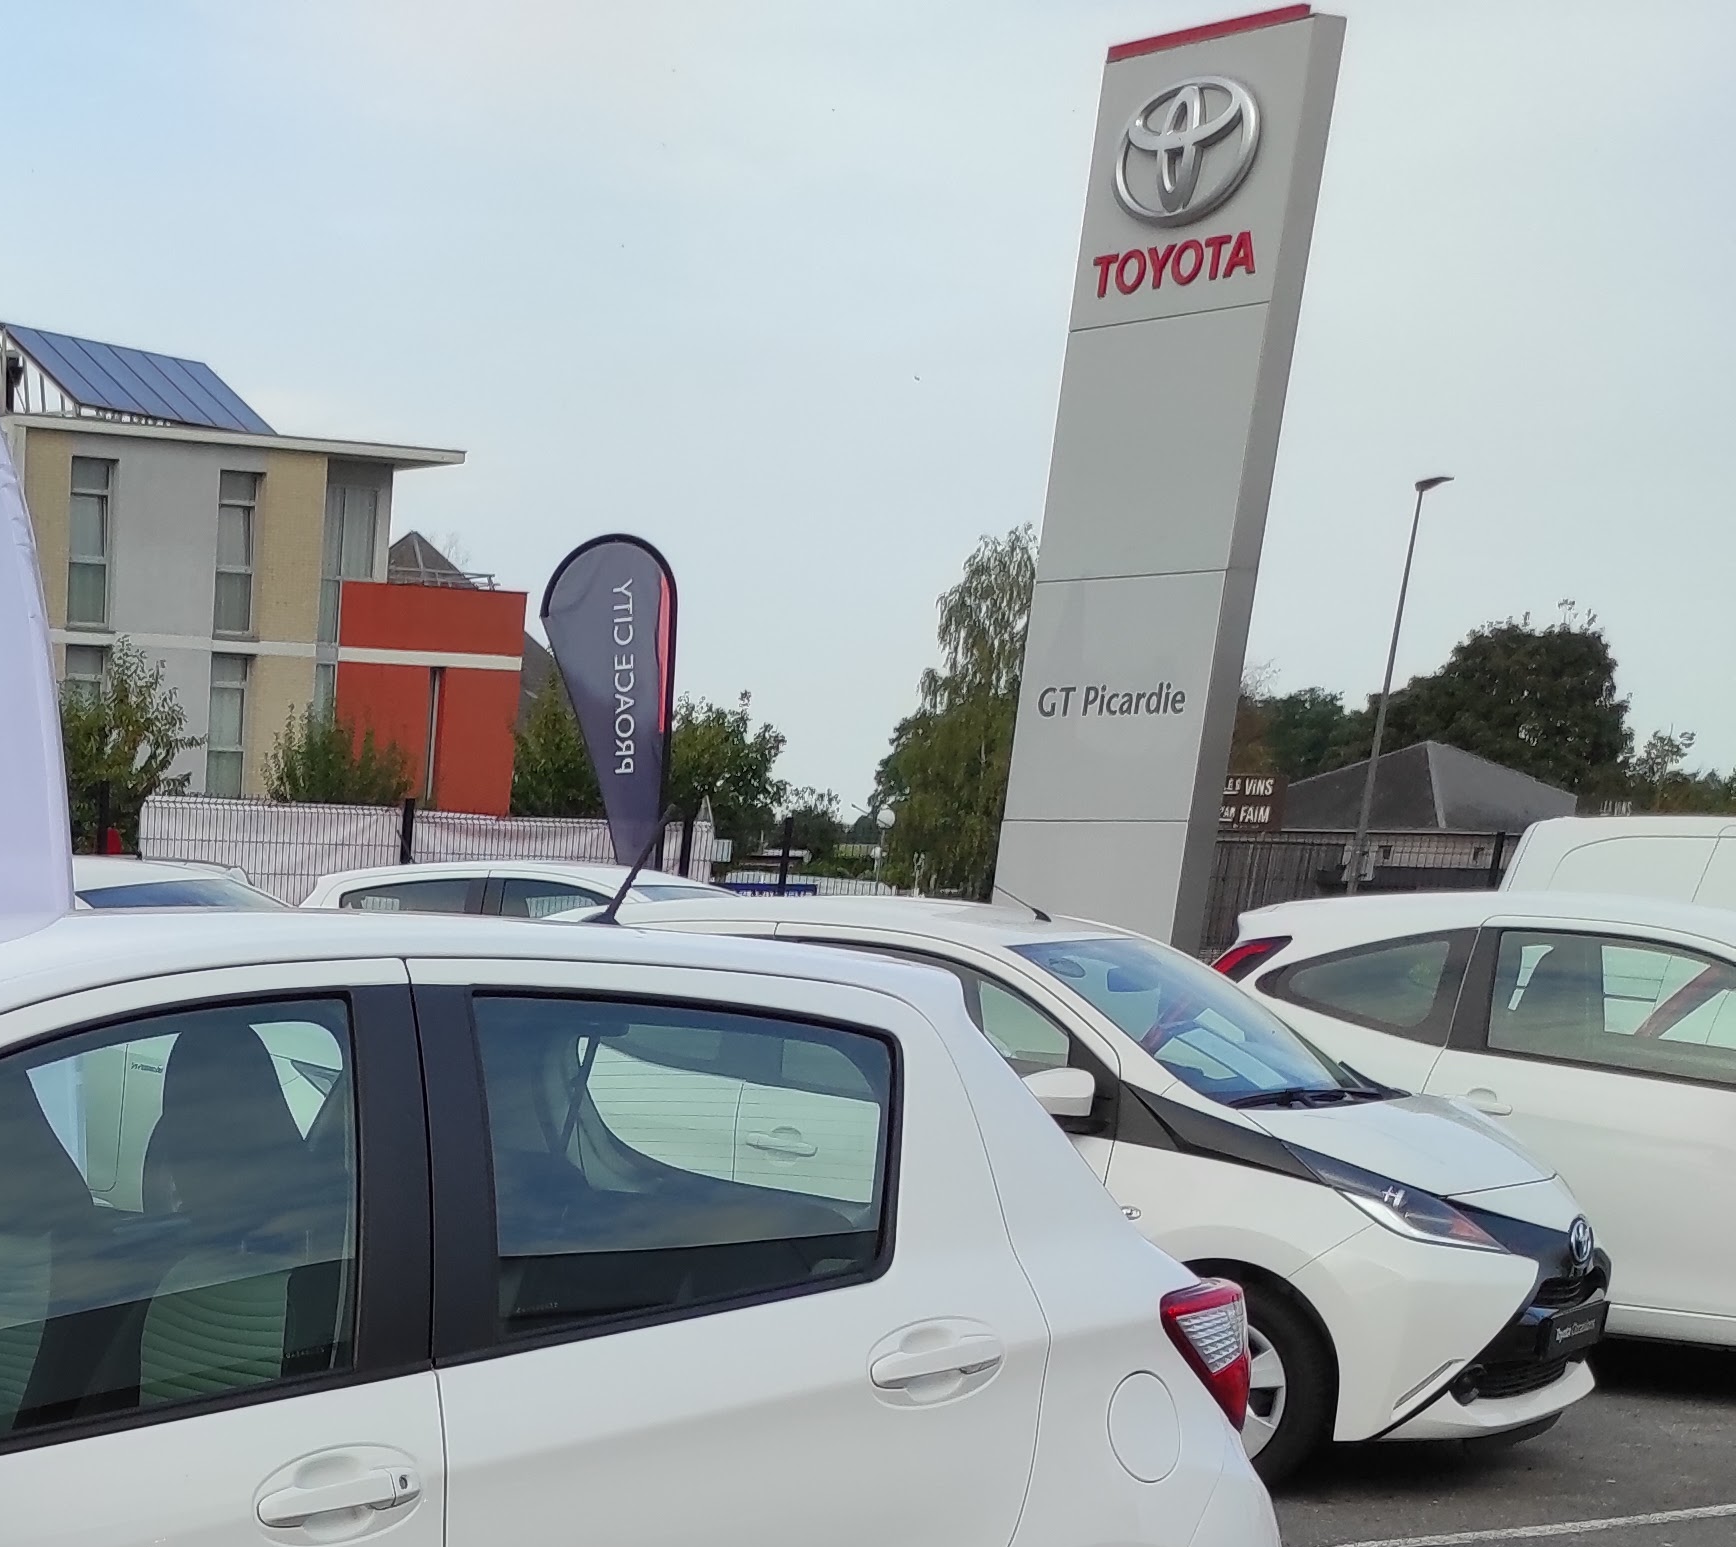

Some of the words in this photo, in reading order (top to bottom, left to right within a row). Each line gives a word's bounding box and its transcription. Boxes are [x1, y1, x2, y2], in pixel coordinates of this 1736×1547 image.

[1093, 230, 1256, 299] TOYOTA
[1038, 686, 1077, 717] GT
[1081, 680, 1186, 717] Picardie
[1238, 805, 1271, 824] FAIM
